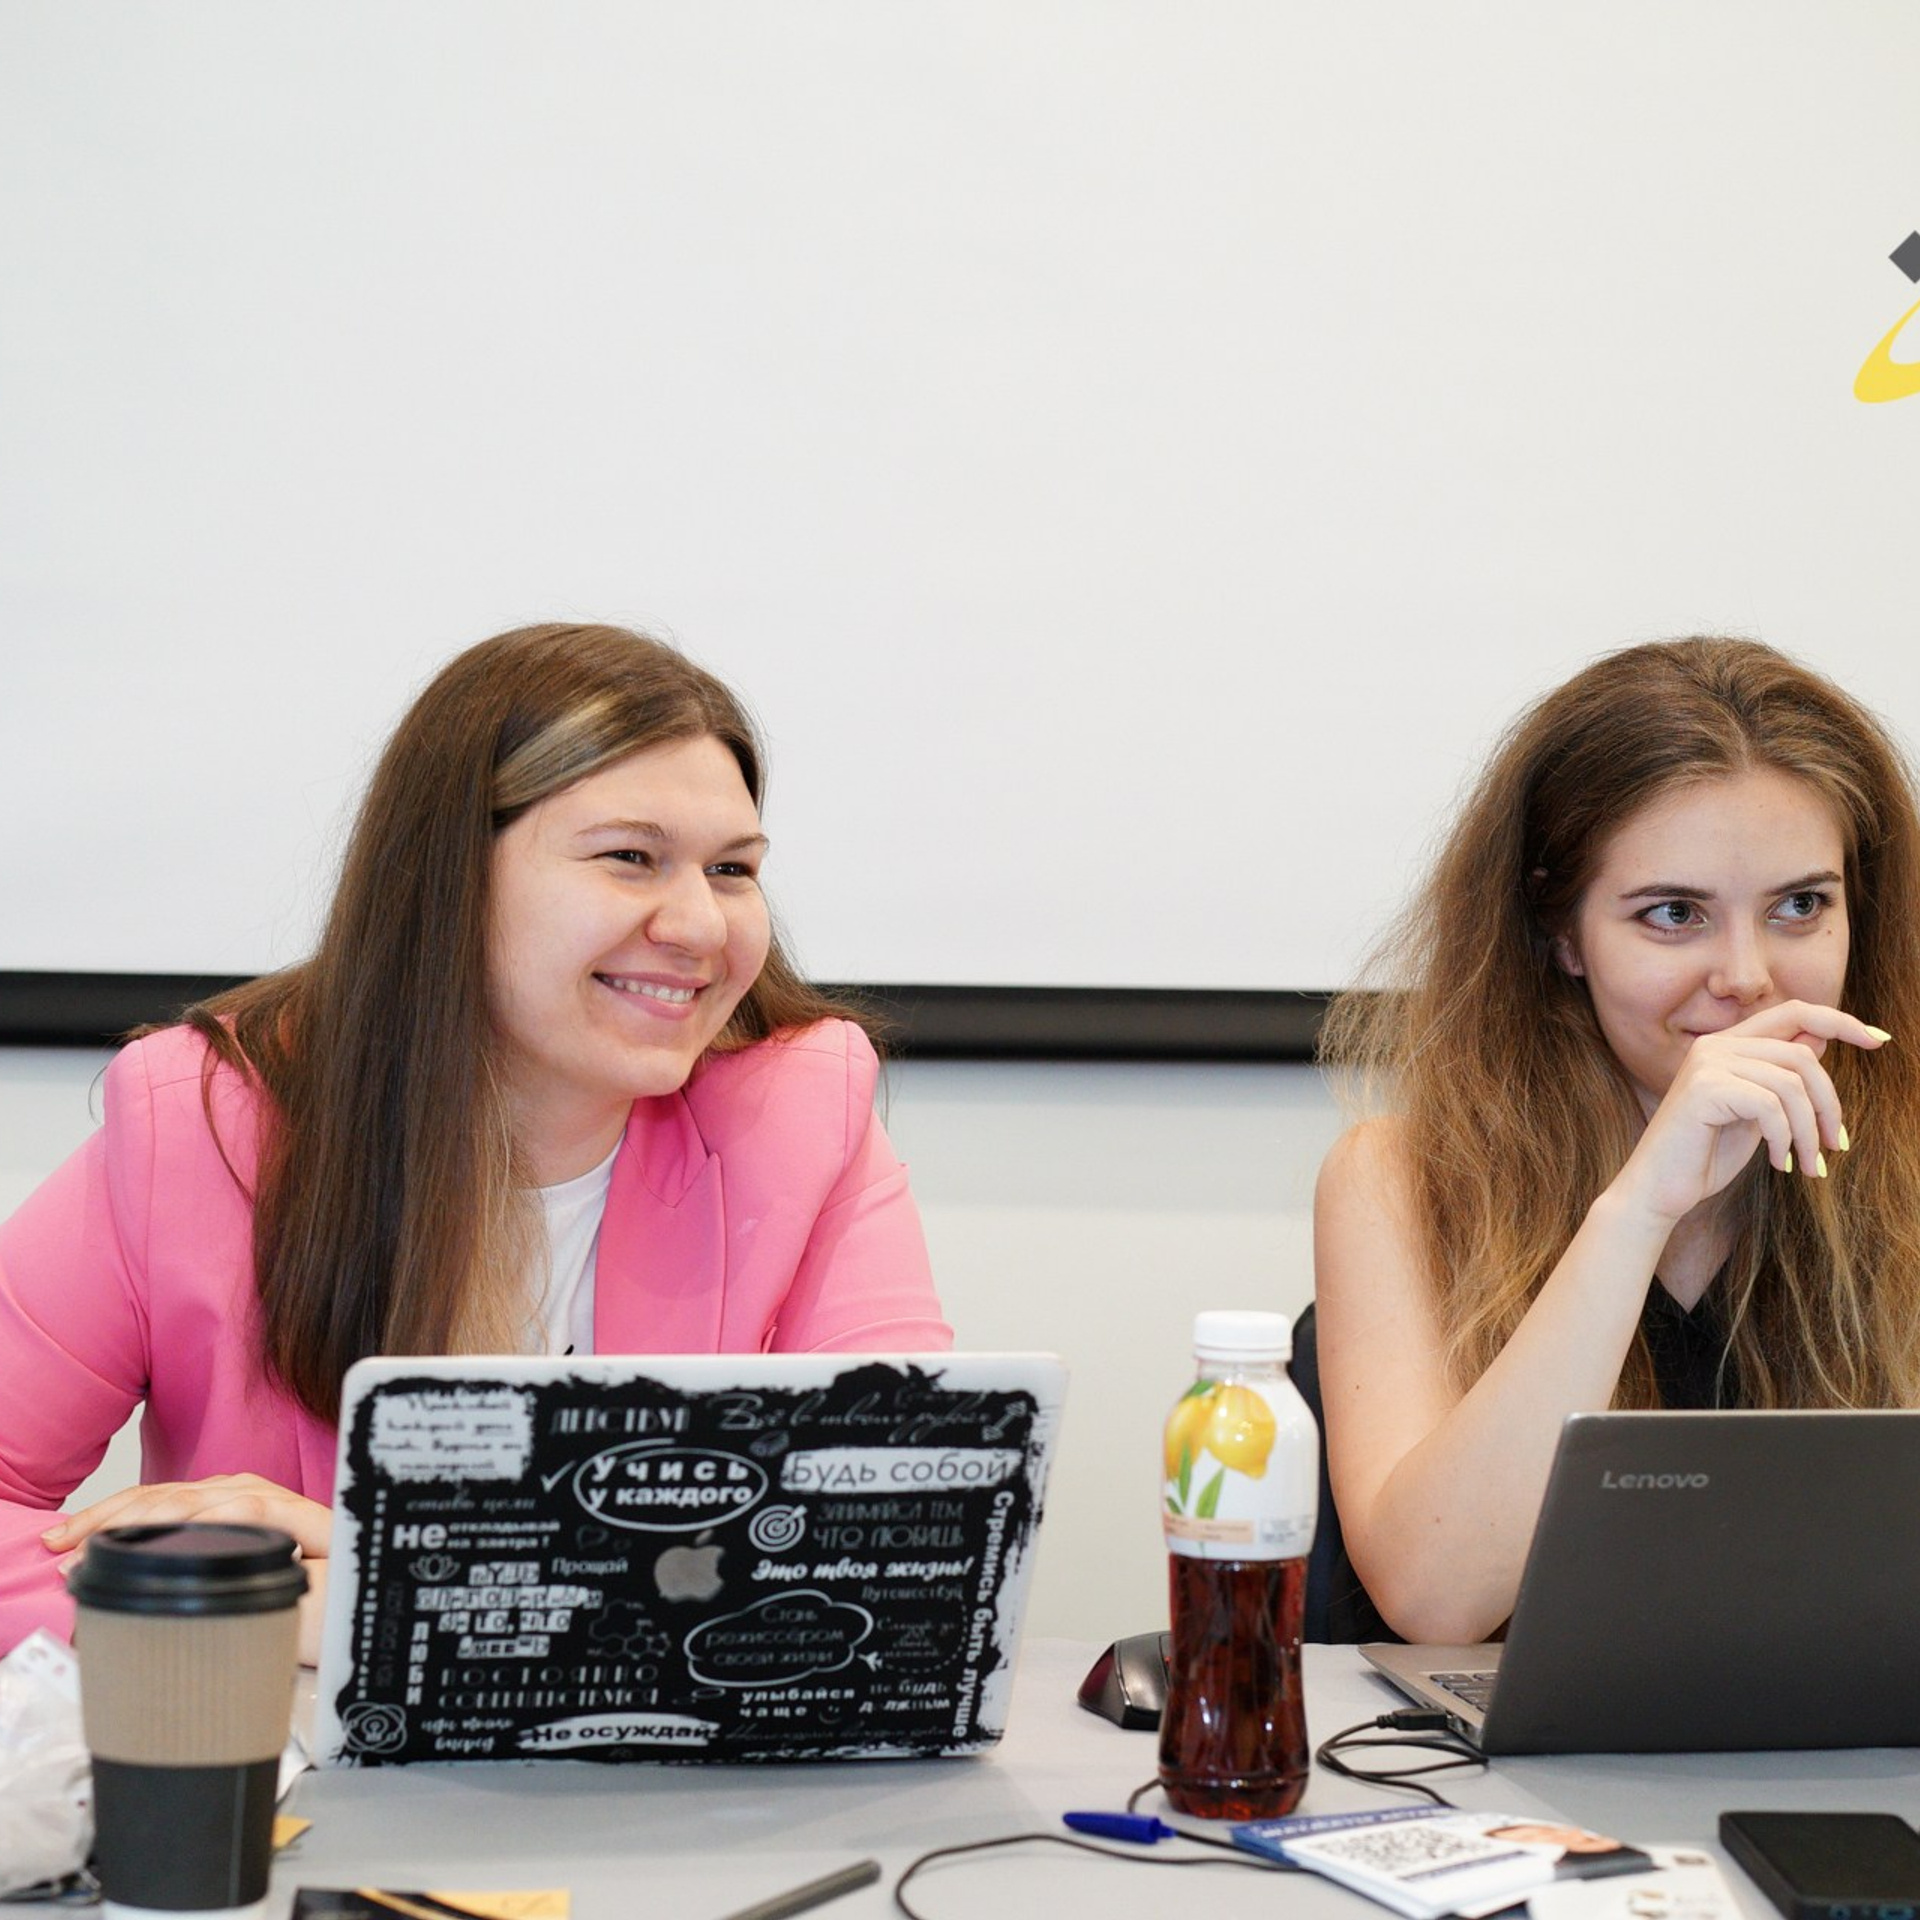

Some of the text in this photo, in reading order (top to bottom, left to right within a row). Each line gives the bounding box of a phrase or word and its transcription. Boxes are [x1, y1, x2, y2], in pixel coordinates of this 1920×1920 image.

[791, 1452, 1009, 1492] Будь собой
[1600, 1470, 1710, 1489] Lenovo
[589, 1486, 753, 1511] у каждого
[448, 1537, 470, 1549] на
[552, 1556, 628, 1576] Прощай
[751, 1556, 975, 1582] Это твоя жизнь!
[952, 1490, 1015, 1738] Стремись быть лучше
[741, 1686, 855, 1704] улыбайся
[740, 1705, 807, 1718] чаще
[532, 1727, 571, 1743] Не
[579, 1722, 711, 1741] осуждай
